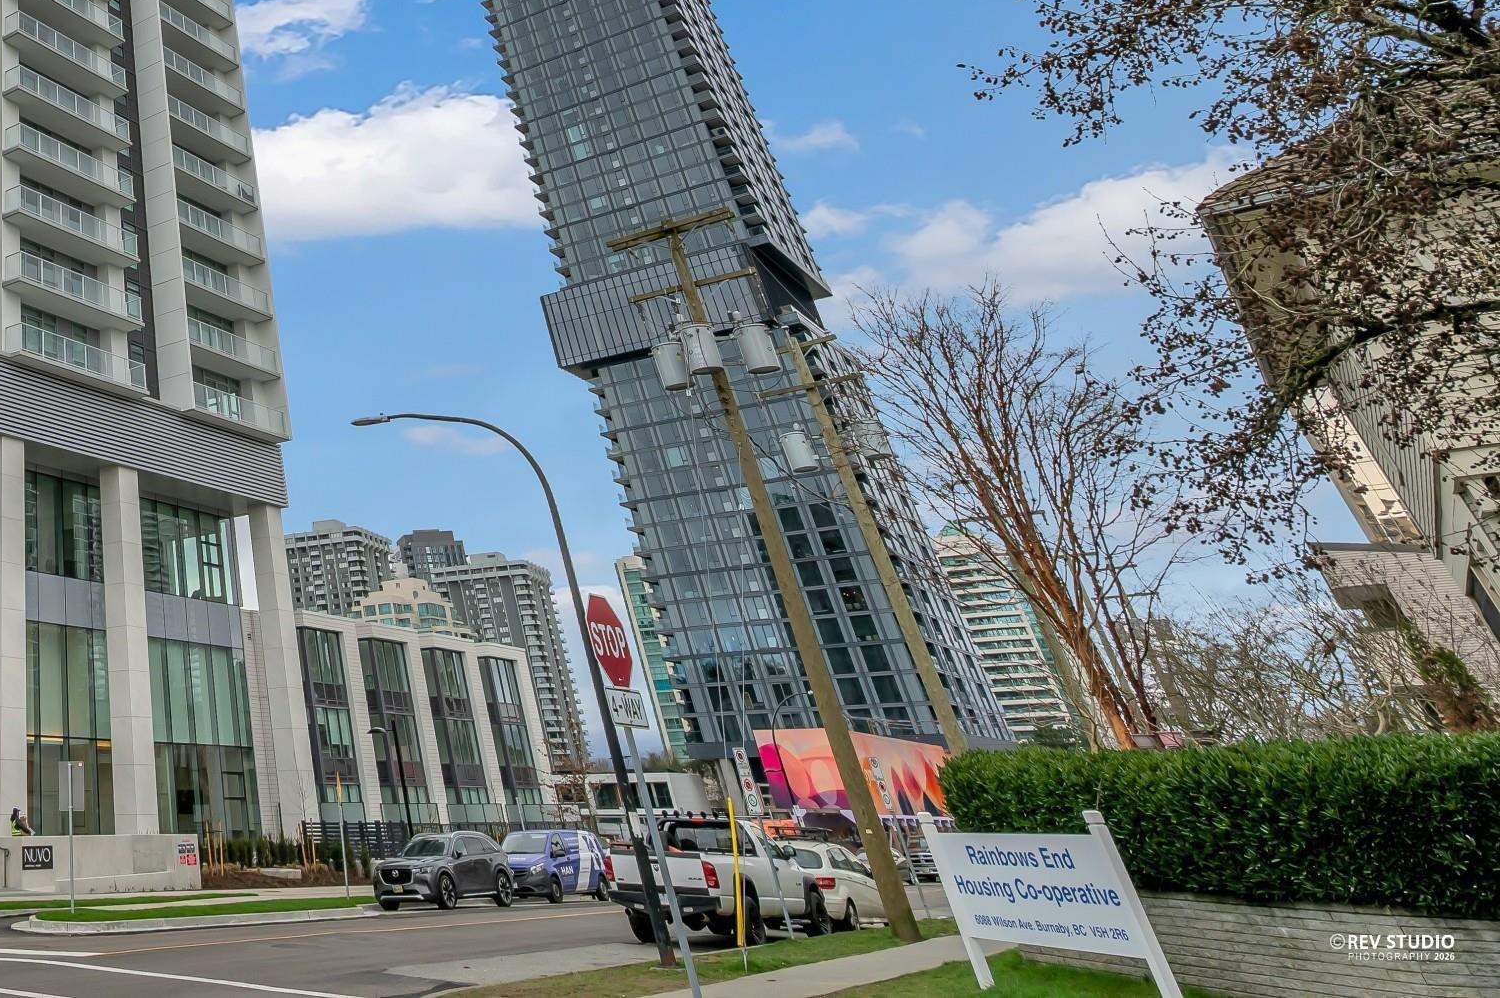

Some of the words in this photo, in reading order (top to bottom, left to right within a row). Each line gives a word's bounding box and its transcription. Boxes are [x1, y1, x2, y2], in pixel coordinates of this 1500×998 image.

[590, 621, 626, 659] STOP
[611, 694, 643, 720] 4-WAY
[24, 847, 51, 862] NUVO
[965, 844, 1039, 868] Rainbows
[1038, 847, 1076, 870] End
[953, 874, 1016, 903] Housing
[1014, 877, 1121, 908] Co-operative
[991, 915, 1018, 929] Wilson
[1035, 920, 1073, 937] Burnaby,
[1072, 923, 1087, 937] BC
[1089, 925, 1110, 939] V5H
[1109, 927, 1129, 941] 2R6
